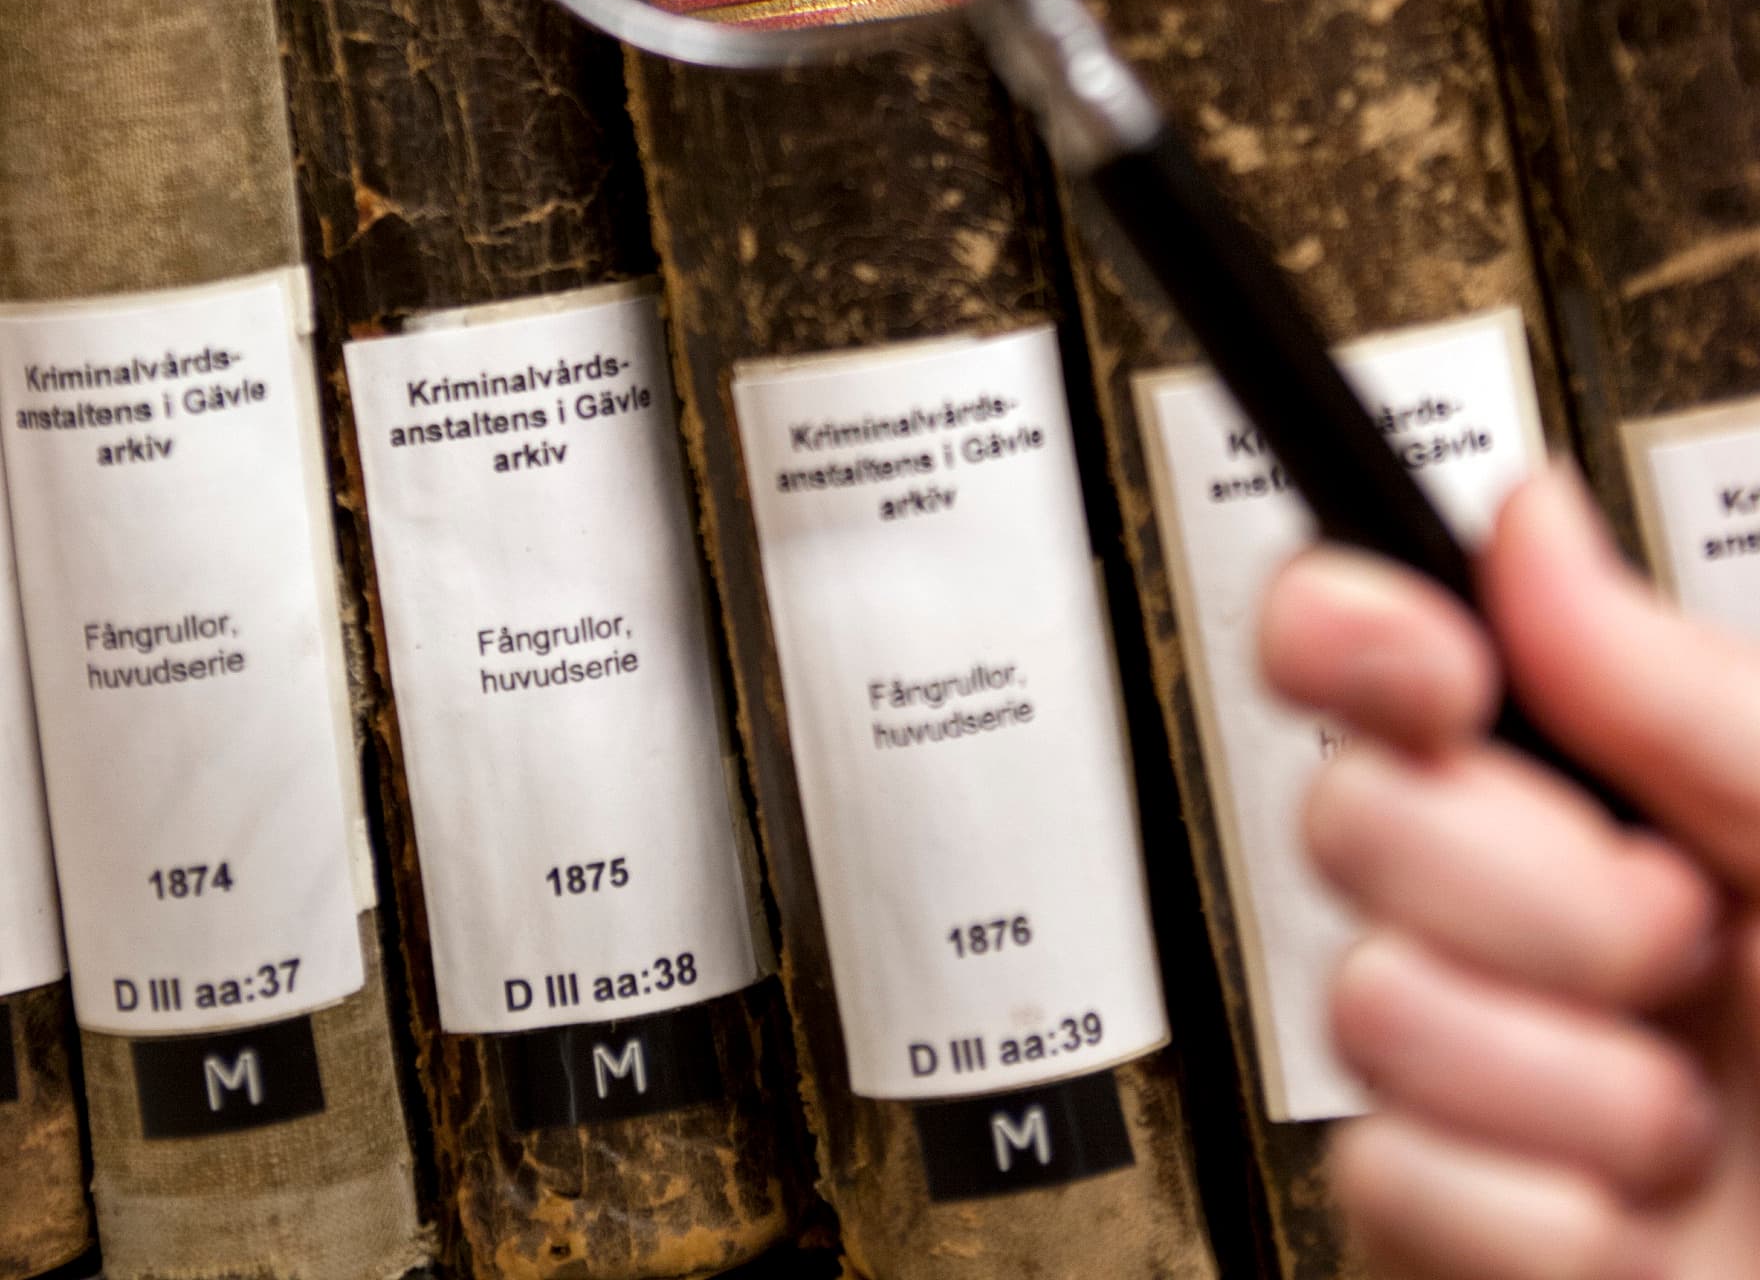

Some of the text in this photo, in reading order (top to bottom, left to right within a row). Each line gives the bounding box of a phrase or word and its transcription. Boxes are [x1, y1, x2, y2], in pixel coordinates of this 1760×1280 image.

[24, 345, 244, 394] Kriminalvårds-
[407, 353, 630, 408] Kriminalvårds-
[15, 378, 267, 431] anstaltens i Gävle
[390, 385, 652, 448] anstaltens i Gävle
[97, 434, 174, 467] arkiv
[493, 441, 569, 473] arkiv
[776, 425, 1045, 493] anstaltens i Gävle
[879, 487, 957, 521] arkiv
[84, 613, 239, 655] Fångrullor,
[477, 615, 632, 656] Fångrullor,
[88, 648, 246, 690] huvudserie
[480, 650, 639, 694] huvudserie
[871, 697, 1035, 749] huvudserie
[149, 862, 234, 900] 1874
[545, 857, 630, 897] 1875
[948, 916, 1032, 959] 1876
[113, 958, 302, 1012] D III aa:37
[504, 952, 698, 1013] D III aa:38
[593, 1038, 648, 1099] M
[908, 1011, 1104, 1078] D III aa:39
[203, 1048, 262, 1112] M
[991, 1105, 1051, 1172] M
